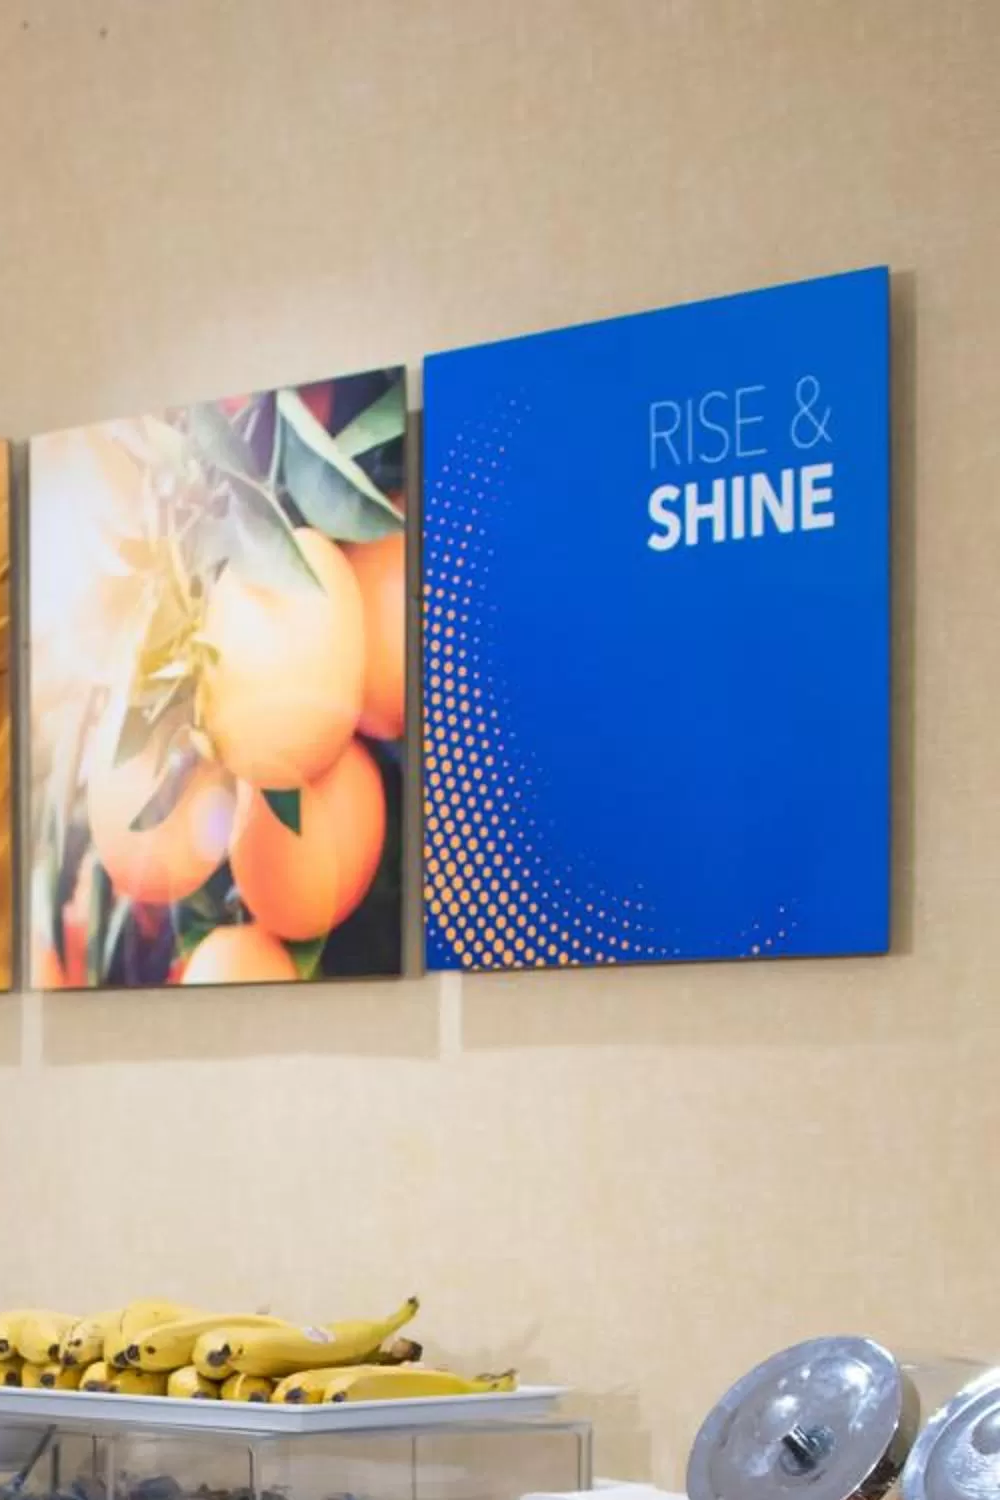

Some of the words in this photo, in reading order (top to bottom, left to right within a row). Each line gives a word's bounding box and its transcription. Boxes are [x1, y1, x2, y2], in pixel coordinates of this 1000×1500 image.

[650, 384, 768, 470] RISE
[791, 375, 832, 449] &
[648, 462, 835, 551] SHINE
